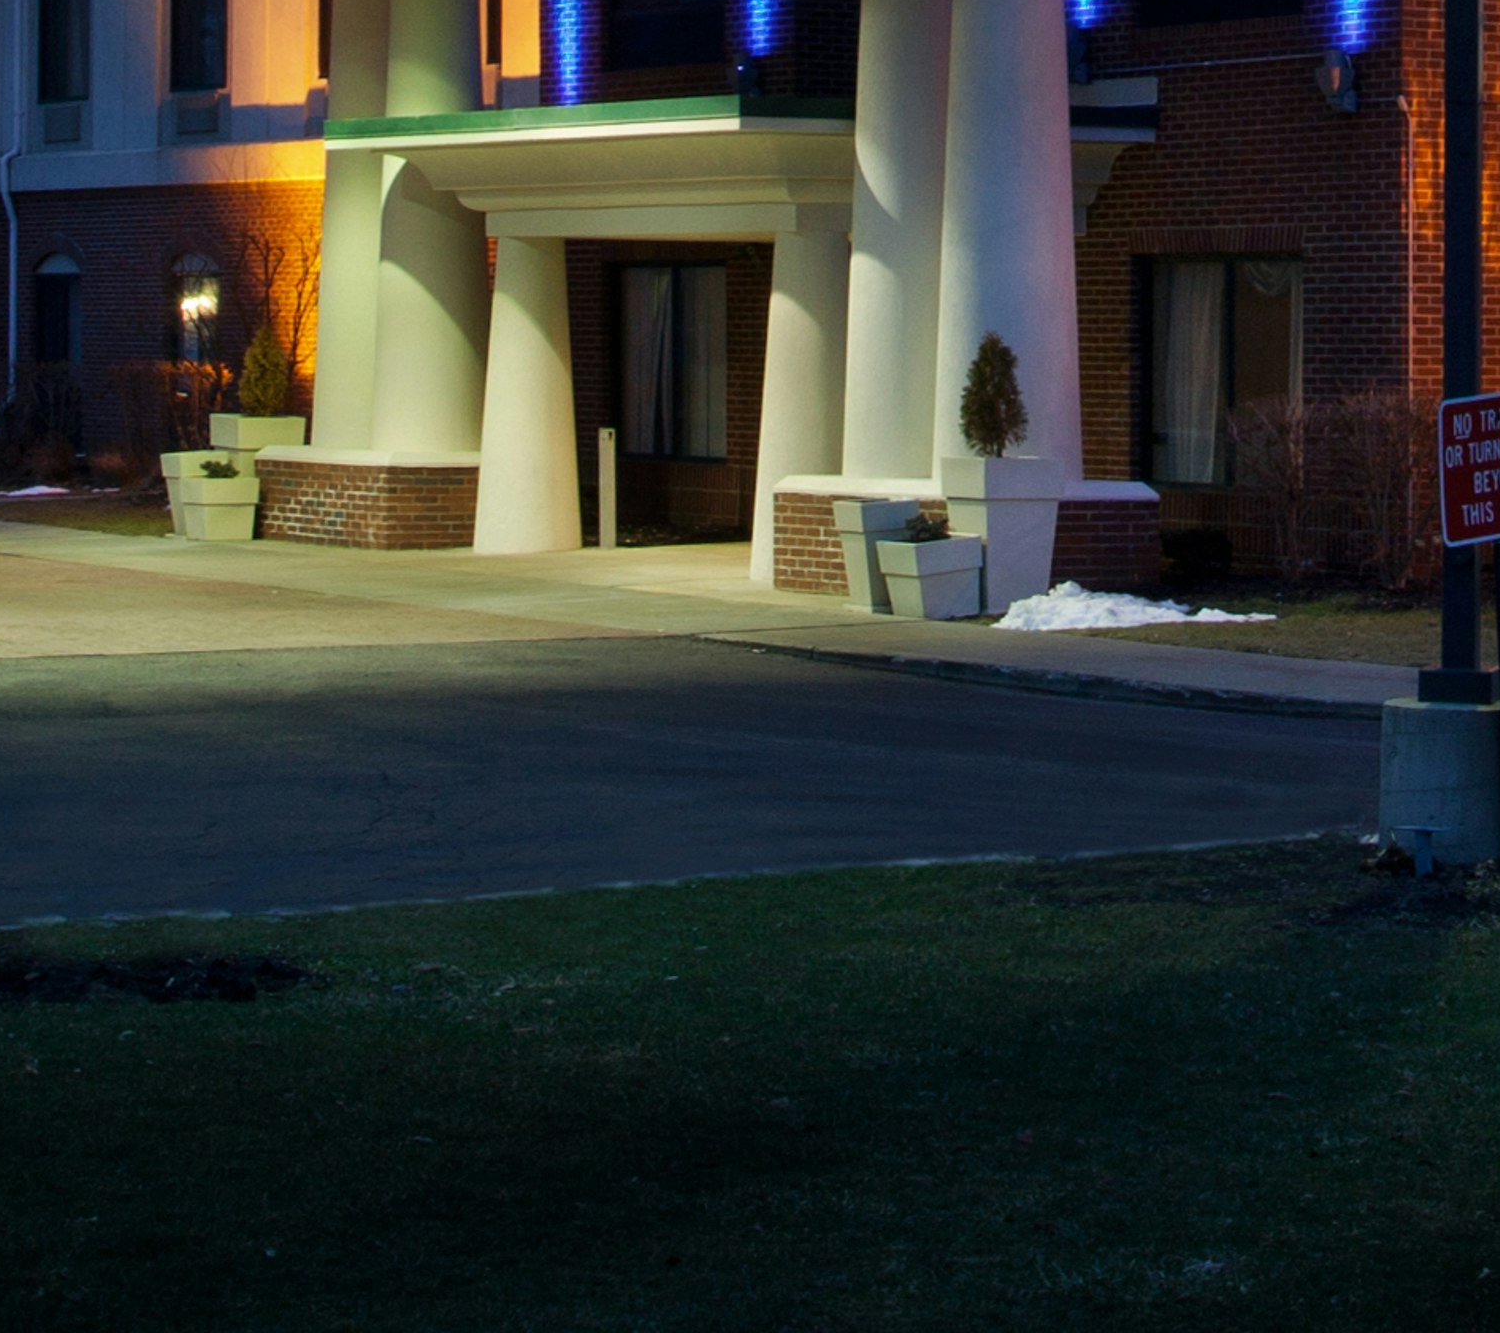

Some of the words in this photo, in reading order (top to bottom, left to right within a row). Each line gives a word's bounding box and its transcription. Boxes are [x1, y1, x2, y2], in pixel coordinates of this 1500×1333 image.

[1453, 413, 1472, 437] NO
[1445, 445, 1463, 468] OR
[1462, 501, 1494, 527] THIS
